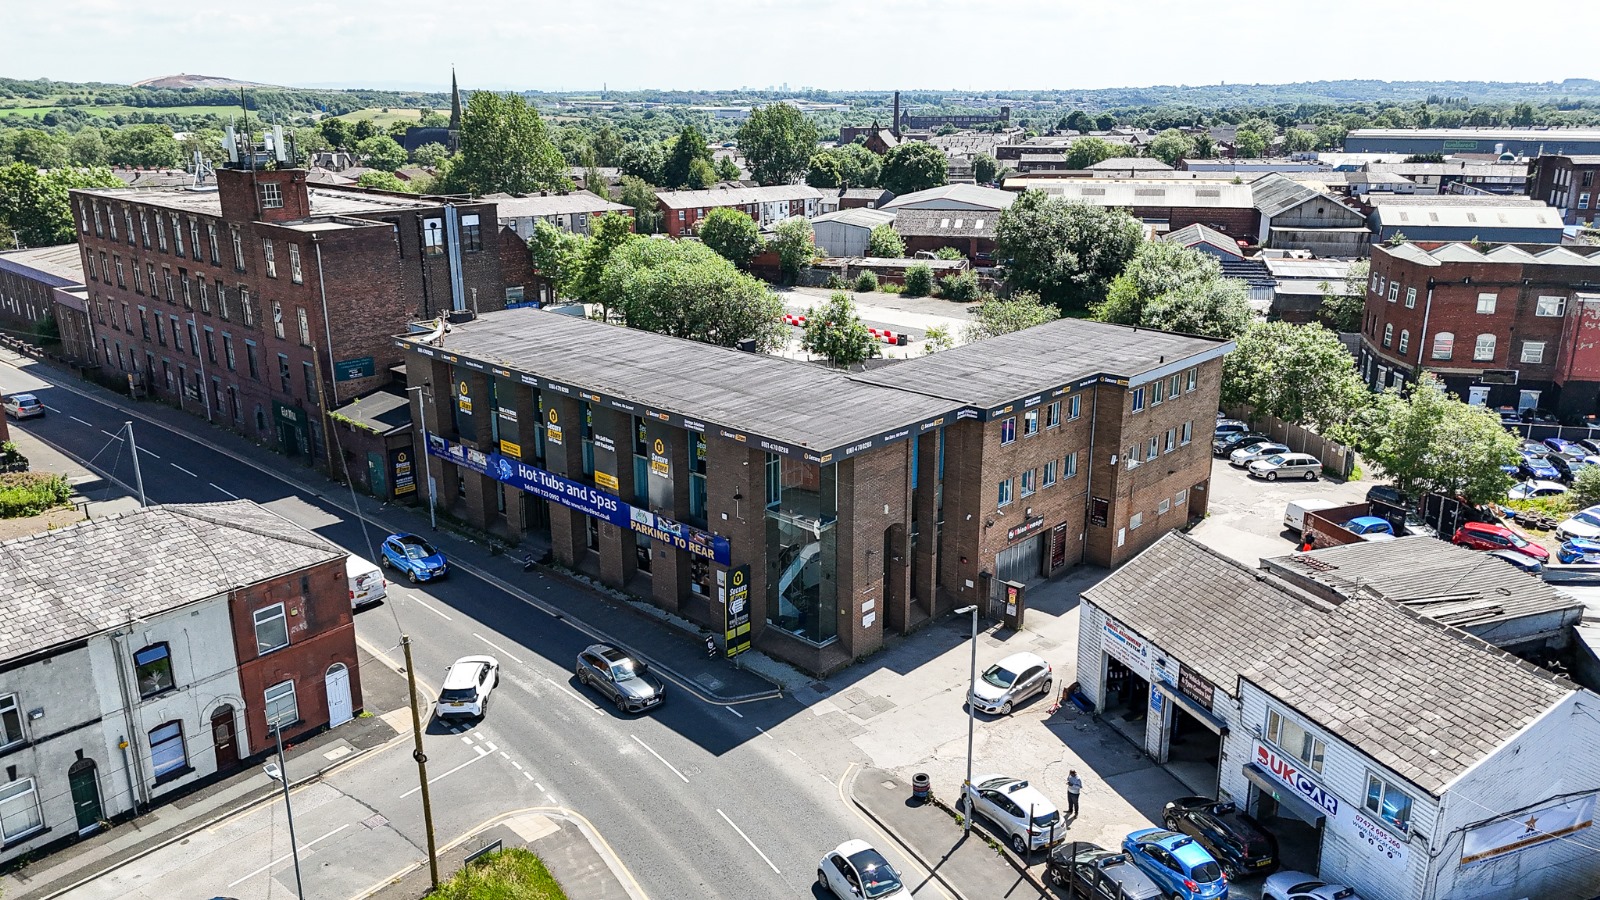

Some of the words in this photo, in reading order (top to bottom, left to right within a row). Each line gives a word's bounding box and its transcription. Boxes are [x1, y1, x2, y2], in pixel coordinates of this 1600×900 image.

[652, 452, 668, 464] Secure
[655, 462, 667, 472] Store
[518, 464, 538, 483] Hot
[539, 472, 564, 492] Tubs
[567, 484, 587, 501] and
[590, 490, 617, 511] Spas
[630, 520, 670, 543] PARKING
[674, 536, 686, 548] TO
[689, 542, 714, 560] REAR
[730, 584, 747, 596] Secure
[1353, 820, 1401, 858] www.bukcar.com
[1356, 815, 1374, 831] 07472
[1376, 829, 1387, 840] 605
[1389, 837, 1400, 849] 260
